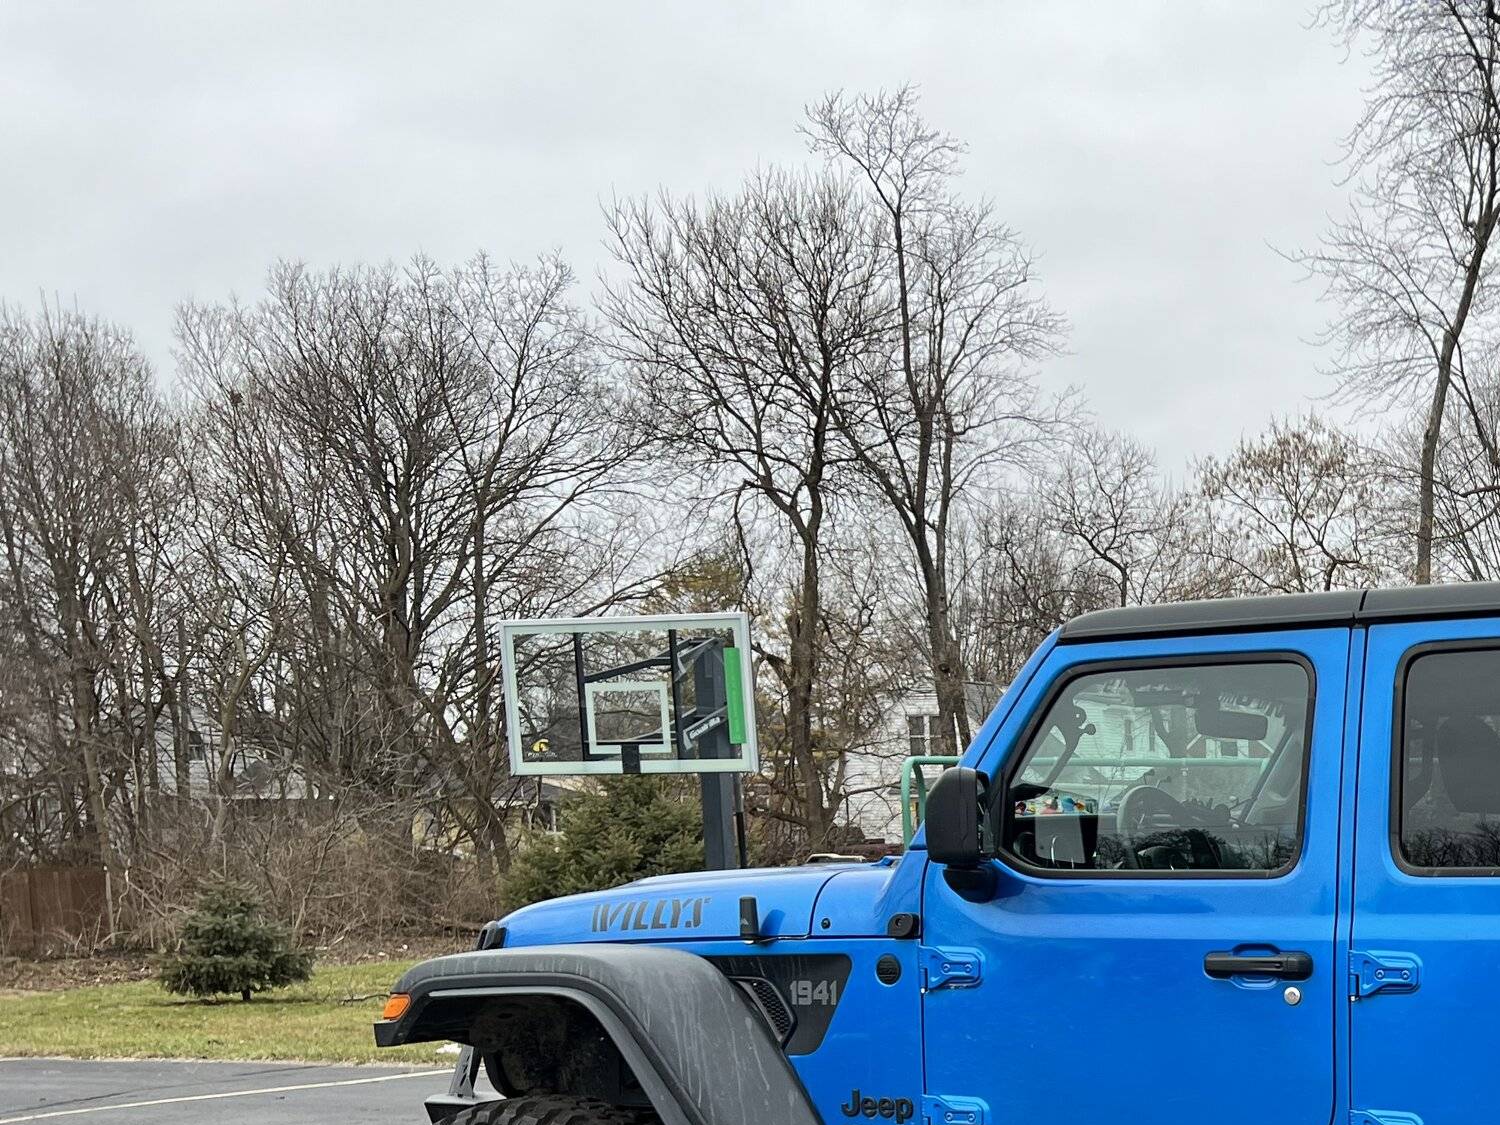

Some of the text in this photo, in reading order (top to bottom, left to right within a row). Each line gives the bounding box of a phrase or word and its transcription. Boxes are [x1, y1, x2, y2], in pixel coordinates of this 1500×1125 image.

[591, 897, 703, 933] WILLYS
[789, 980, 838, 1006] 1941
[841, 1089, 914, 1124] Jeep
